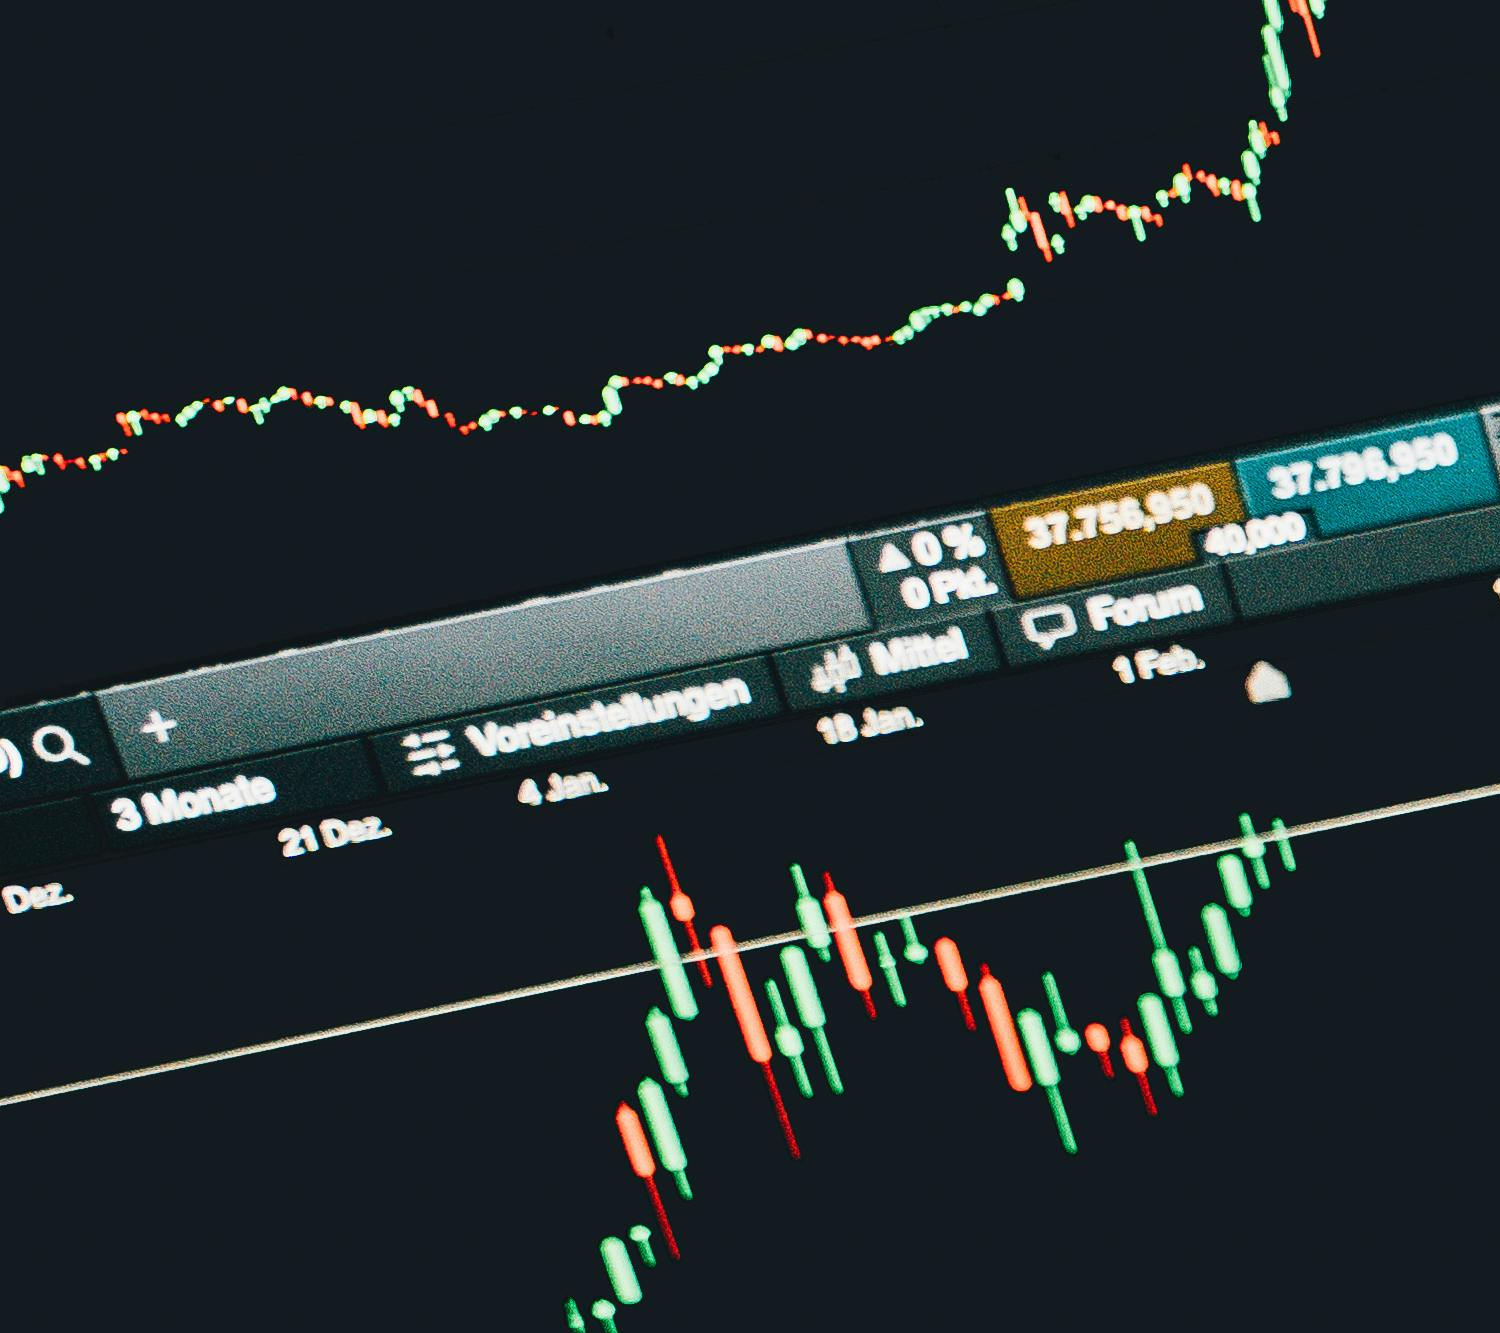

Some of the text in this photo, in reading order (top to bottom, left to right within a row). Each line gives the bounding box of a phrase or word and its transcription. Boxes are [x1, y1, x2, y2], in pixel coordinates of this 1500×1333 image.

[1085, 584, 1204, 632] Forum
[867, 626, 968, 676] Mittel
[464, 677, 751, 757] Voreinstellungen
[140, 774, 276, 826] Monate
